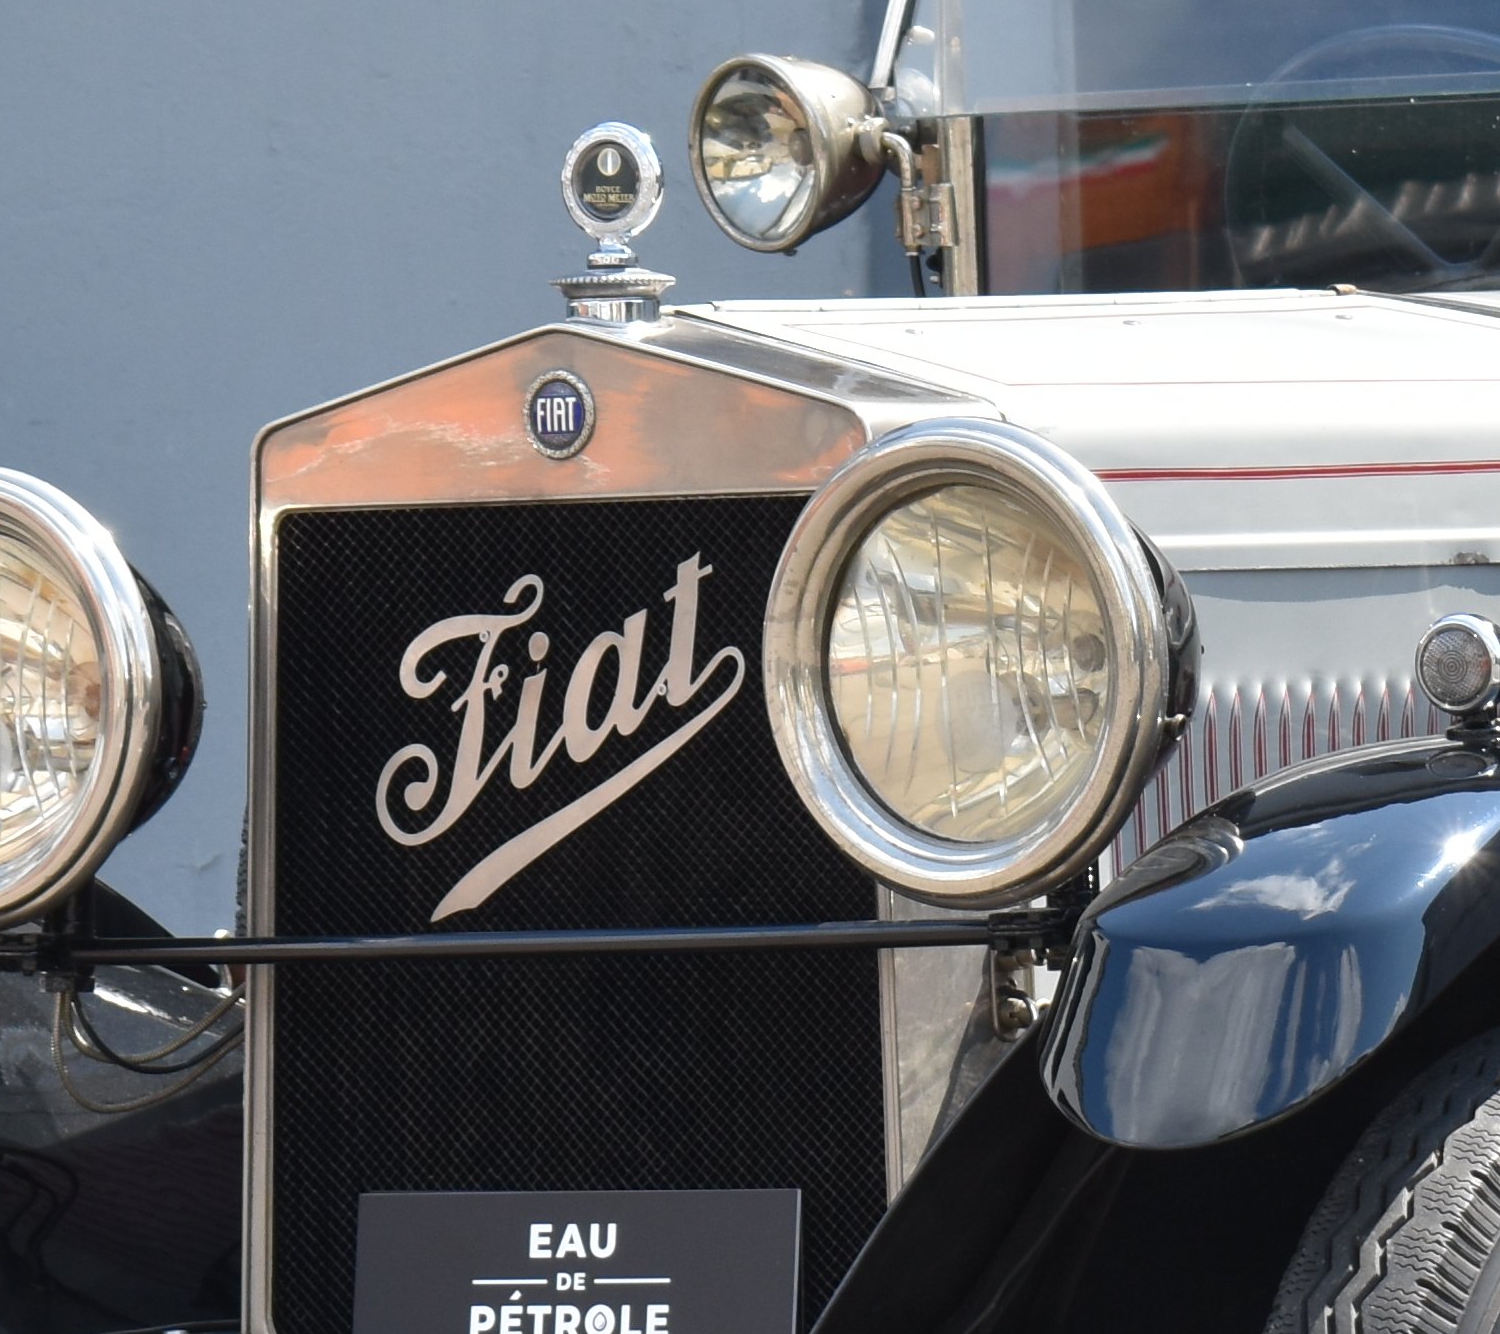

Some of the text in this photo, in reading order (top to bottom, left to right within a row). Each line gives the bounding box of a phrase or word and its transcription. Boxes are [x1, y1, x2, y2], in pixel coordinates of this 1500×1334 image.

[537, 397, 576, 433] FIAT
[376, 551, 746, 921] Fiat
[528, 1222, 618, 1260] EAU
[556, 1272, 586, 1292] DE
